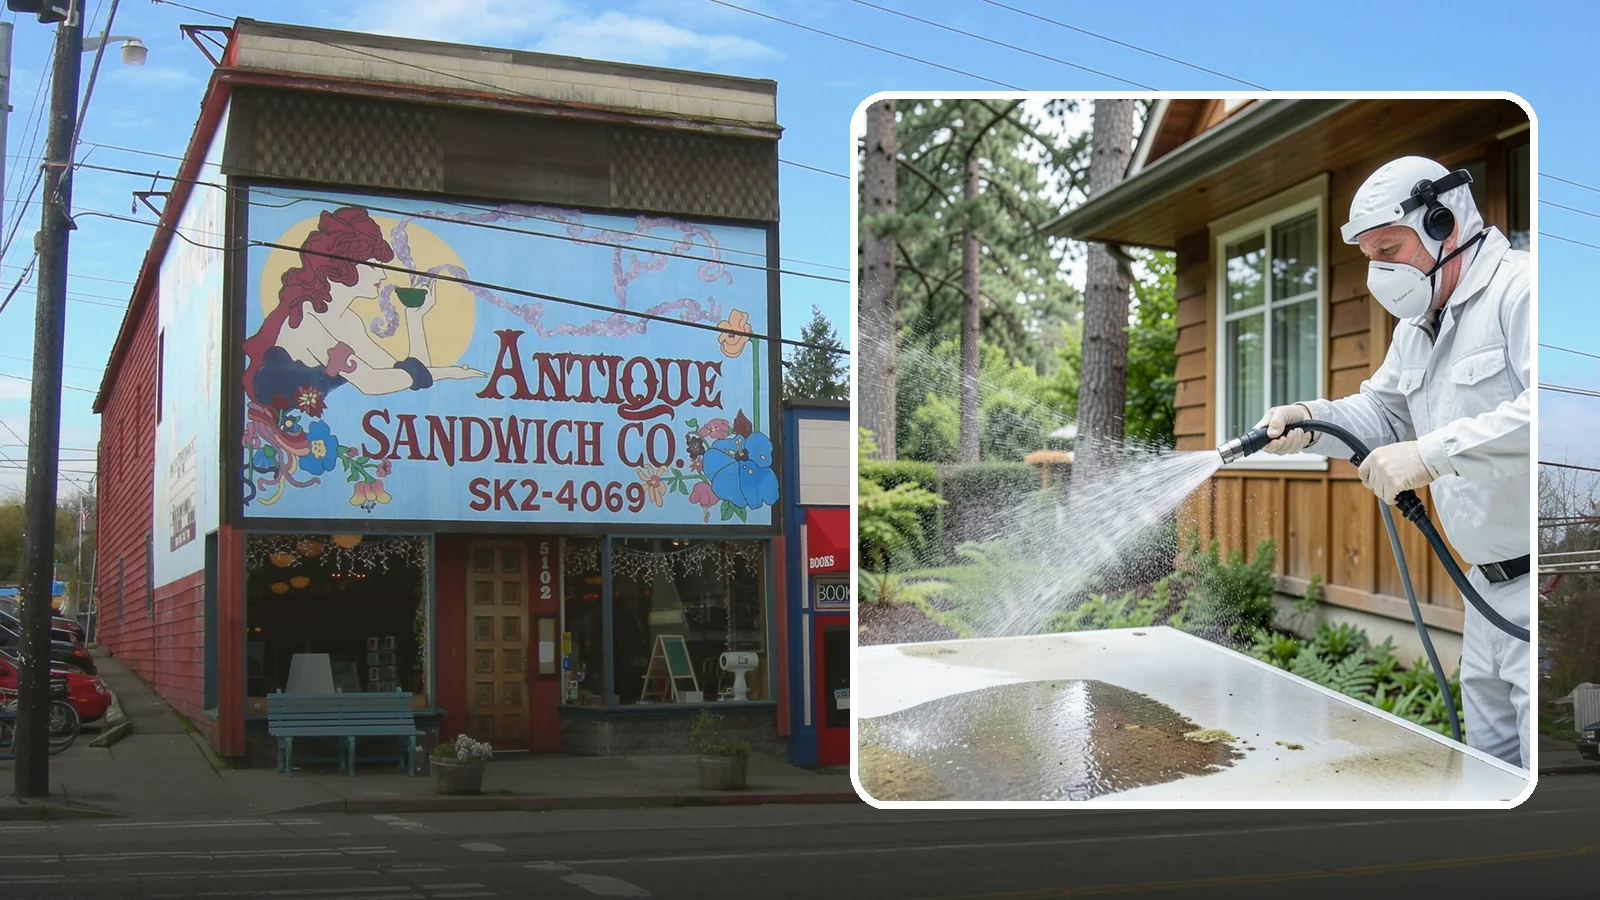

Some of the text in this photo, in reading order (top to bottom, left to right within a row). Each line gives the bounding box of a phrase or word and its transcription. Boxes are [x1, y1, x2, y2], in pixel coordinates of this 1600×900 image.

[476, 329, 723, 420] ANTIQUE
[361, 409, 685, 468] SANDWICH CO.
[468, 477, 646, 513] SK2-4069
[540, 541, 551, 600] 5102
[809, 555, 835, 569] BOOKS
